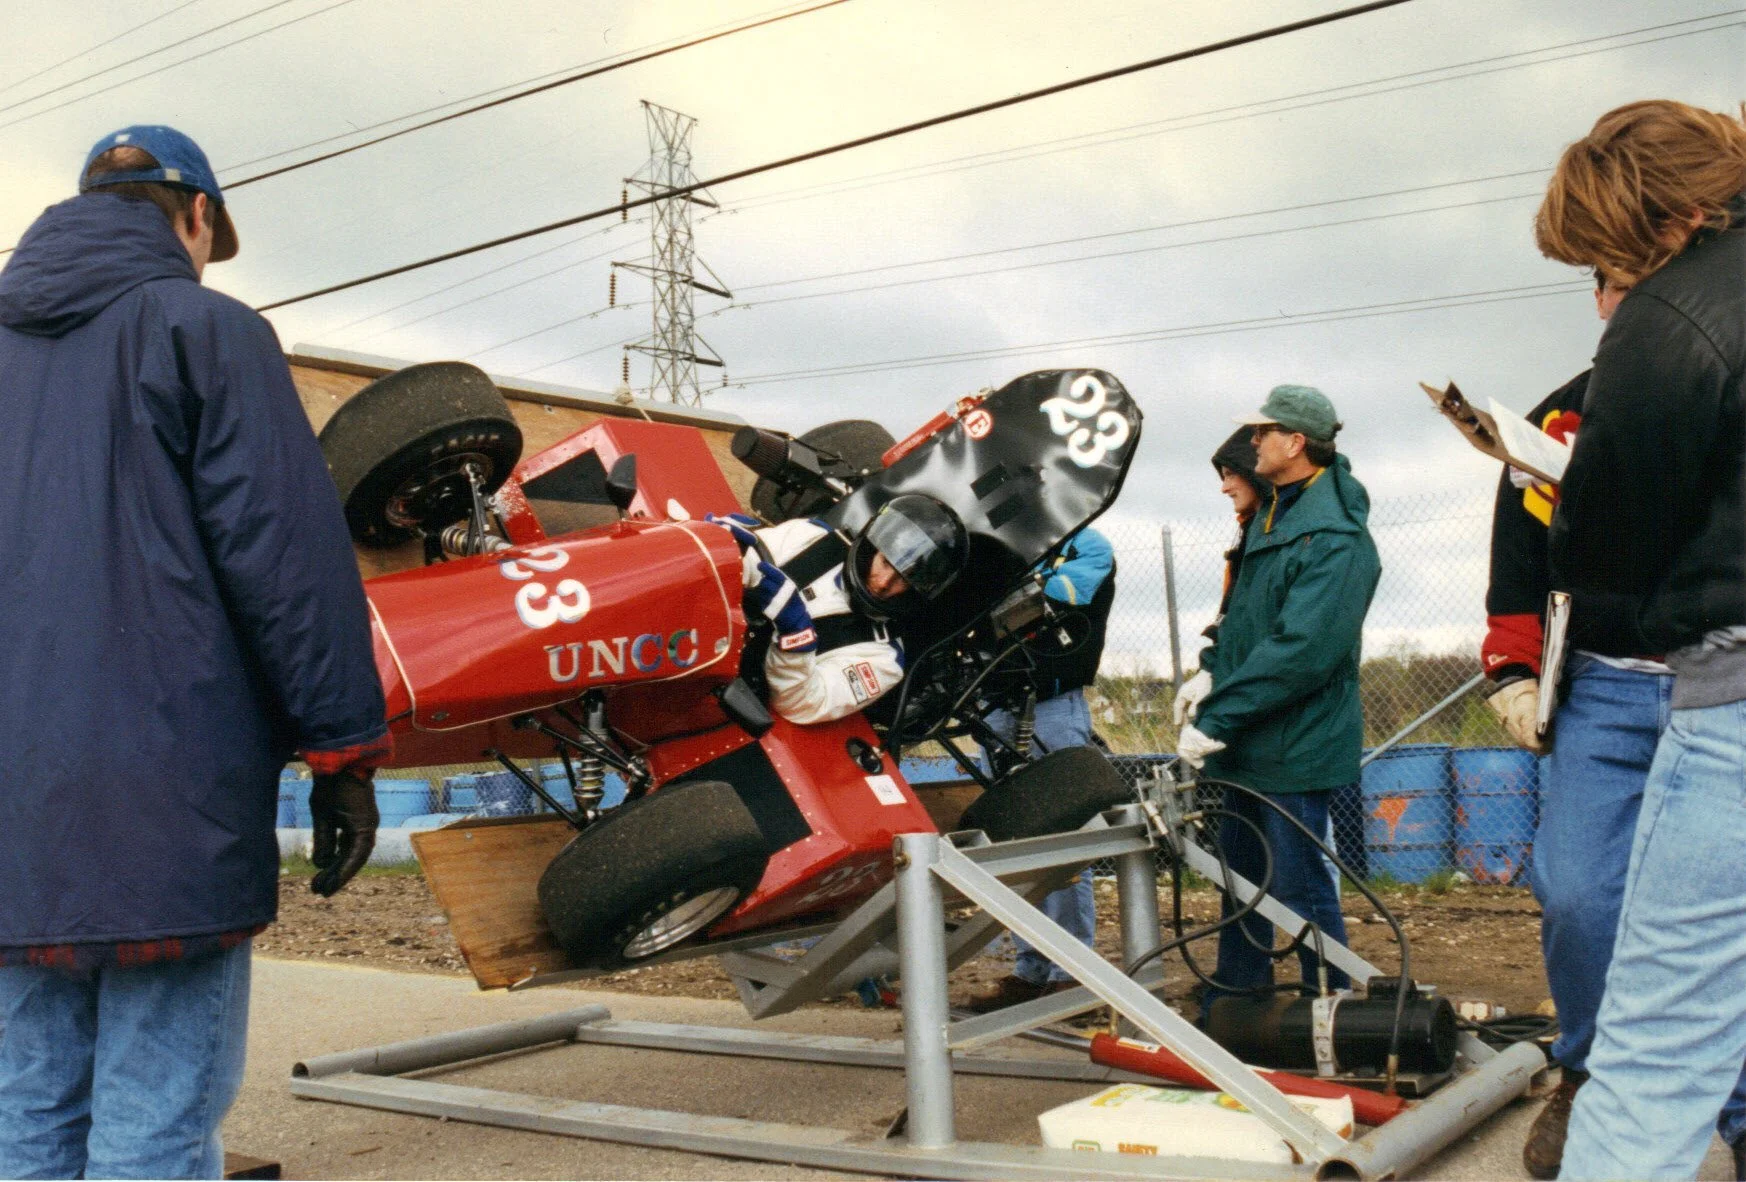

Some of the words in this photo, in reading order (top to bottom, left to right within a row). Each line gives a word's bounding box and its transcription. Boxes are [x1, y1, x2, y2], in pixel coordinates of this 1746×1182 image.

[967, 412, 989, 435] E
[1039, 375, 1130, 469] 23
[500, 548, 590, 629] 23
[543, 628, 699, 683] UNCC
